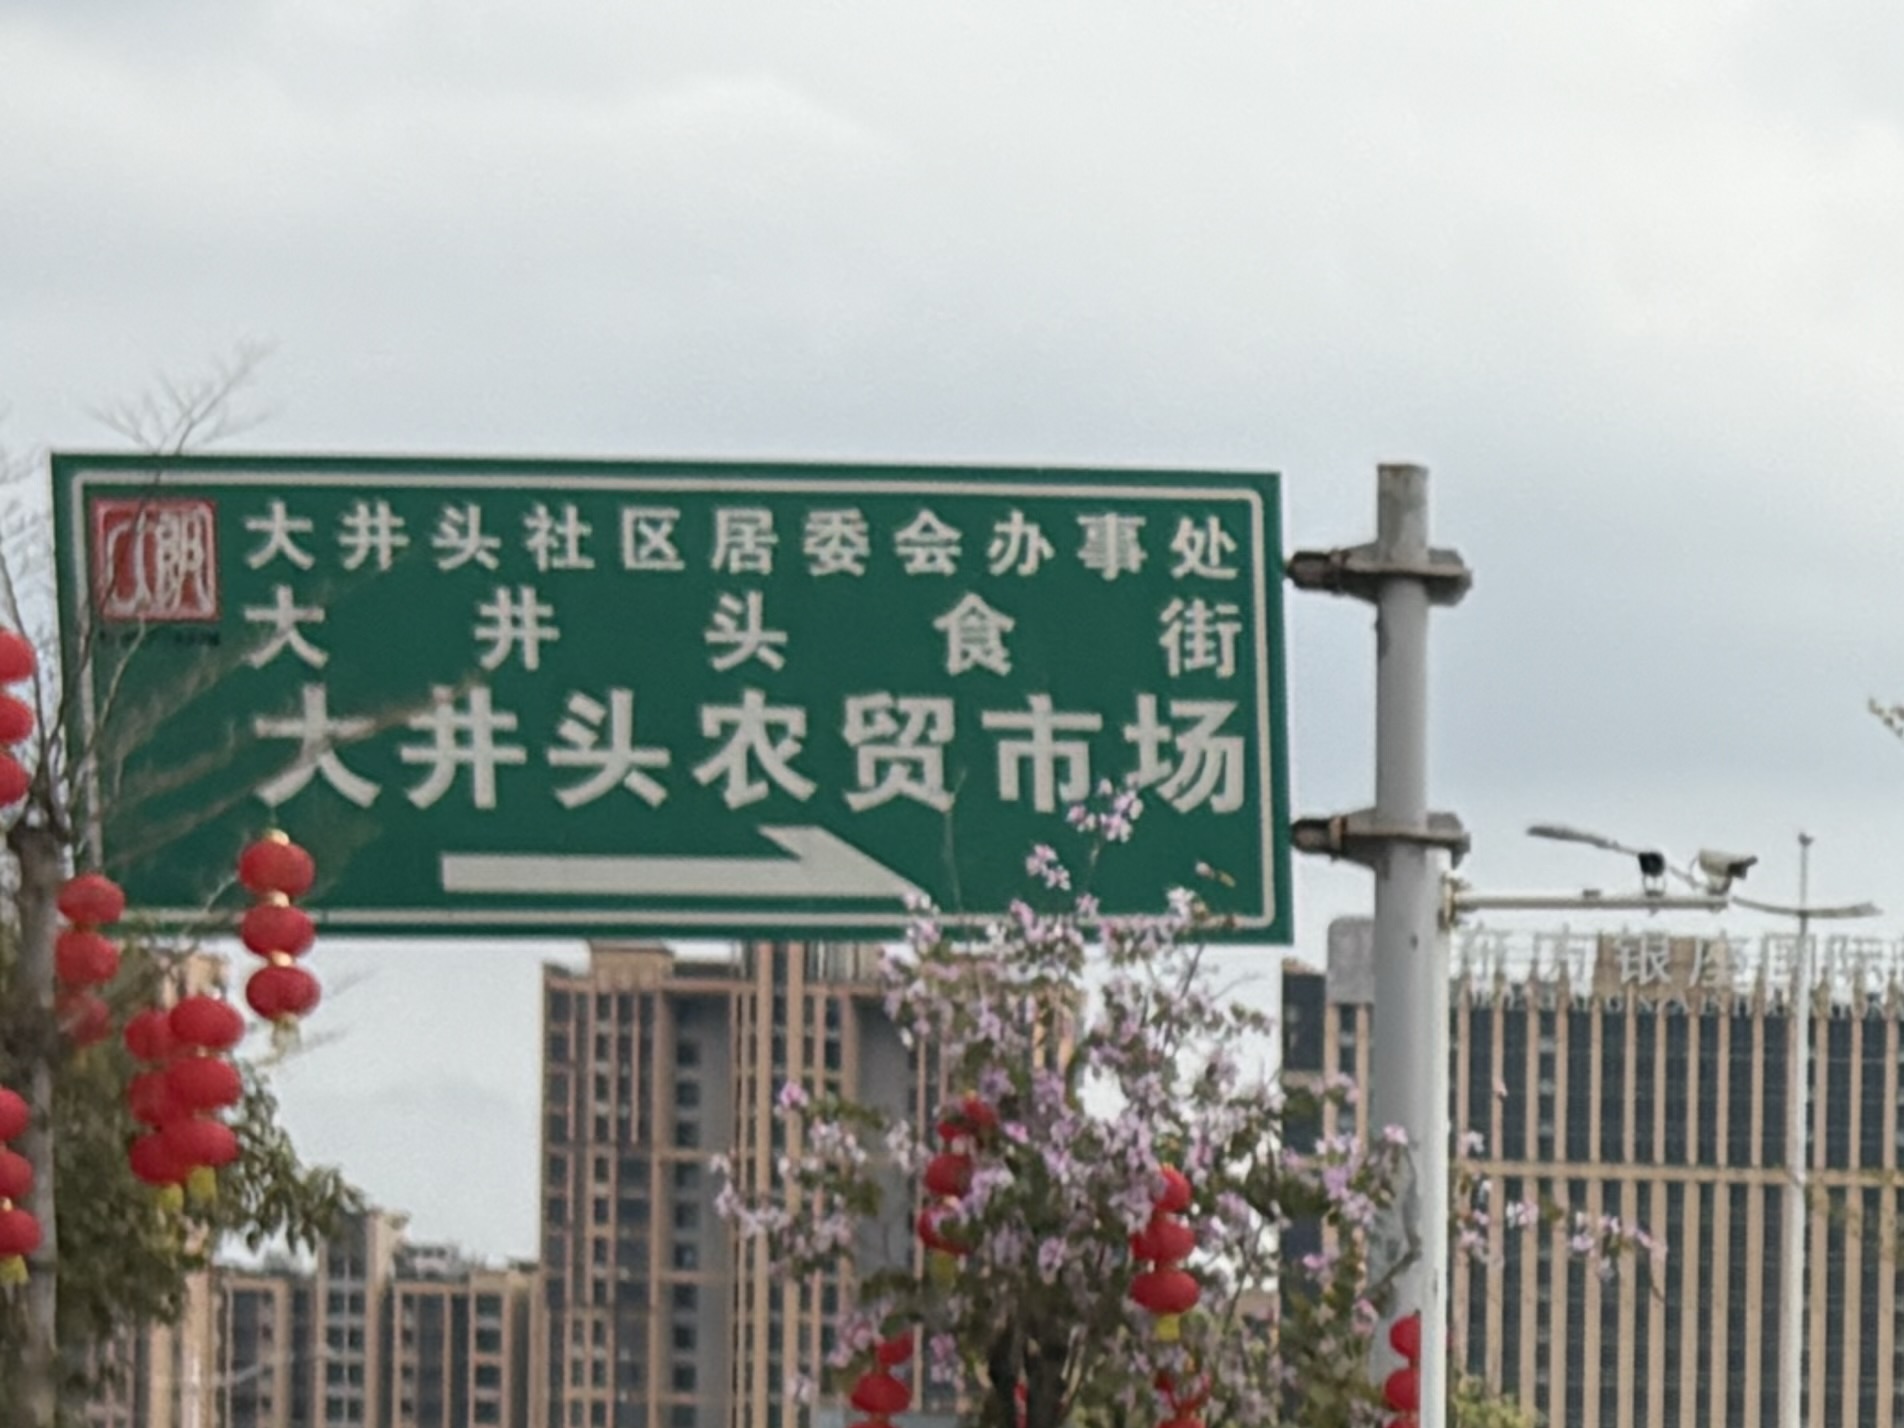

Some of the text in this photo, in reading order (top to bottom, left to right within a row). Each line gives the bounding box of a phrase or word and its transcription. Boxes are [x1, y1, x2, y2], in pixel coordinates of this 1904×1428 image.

[244, 499, 1239, 581] 大井头社区居委会办事处
[244, 584, 1243, 679] 大井头食街
[254, 683, 1246, 814] 大井头农贸市场
